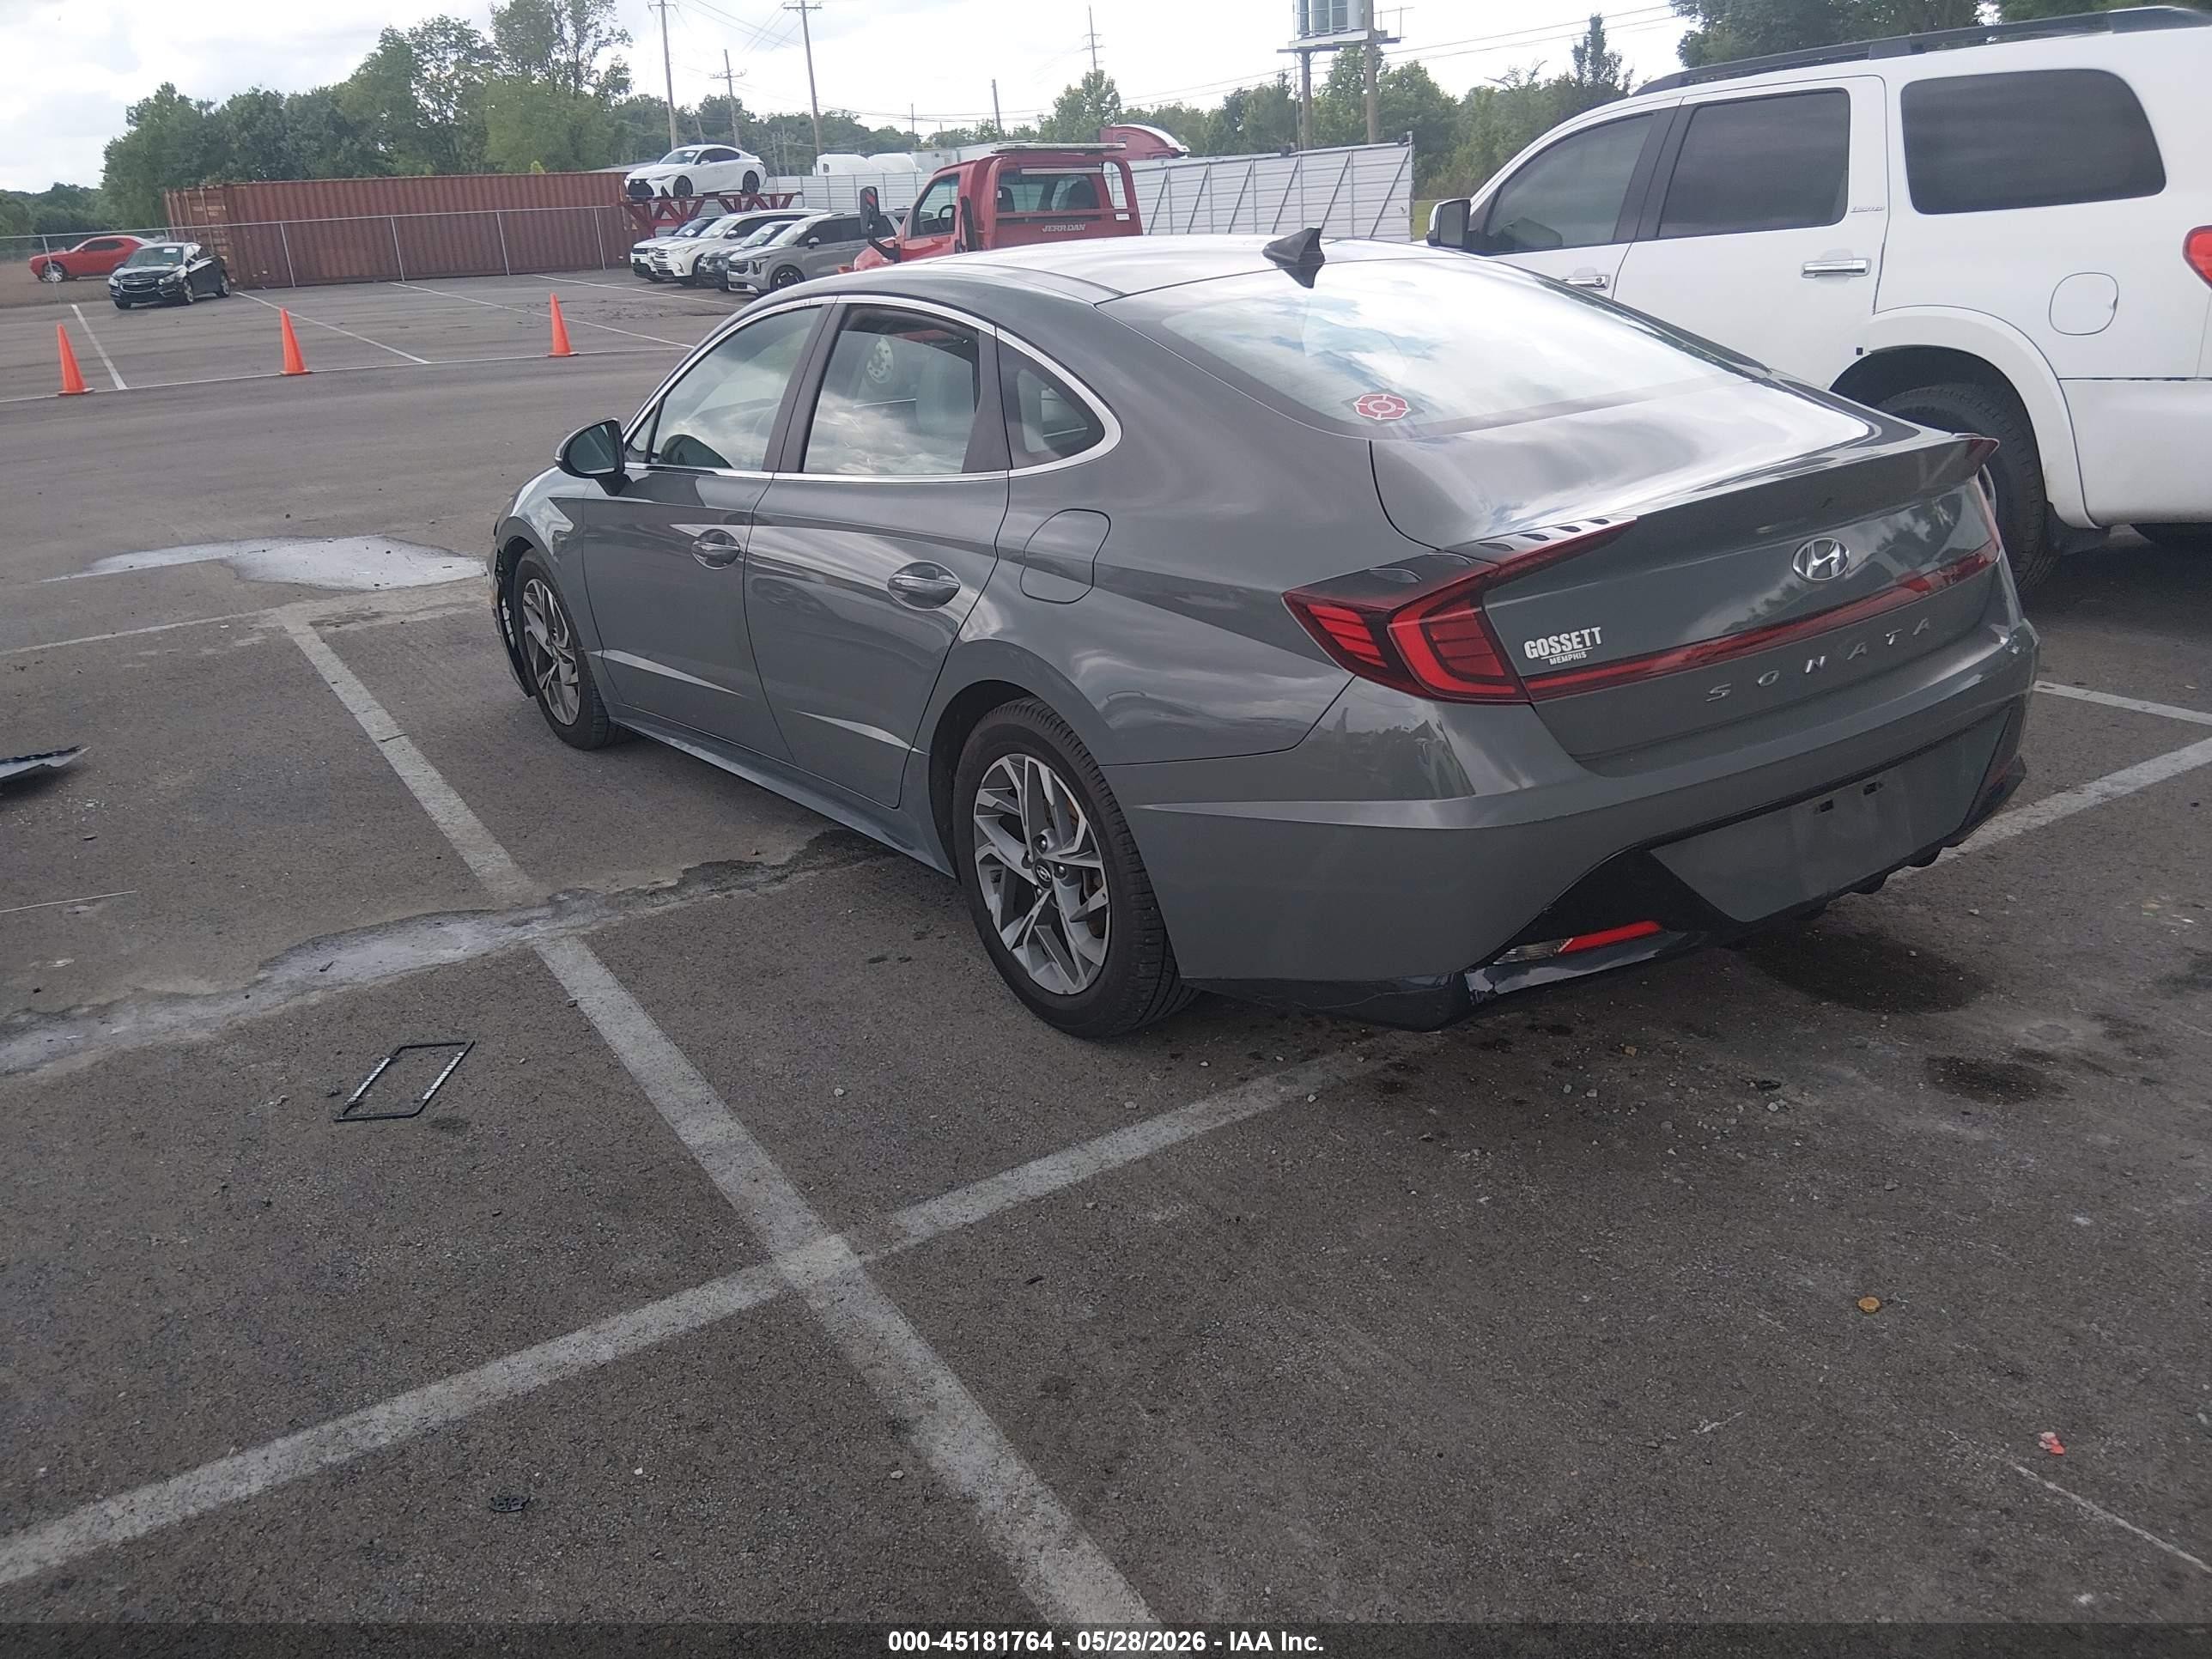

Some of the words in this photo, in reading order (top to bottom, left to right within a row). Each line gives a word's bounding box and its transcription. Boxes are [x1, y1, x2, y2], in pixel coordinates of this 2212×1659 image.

[1524, 627, 1601, 659] GOSSETT
[1549, 651, 1587, 665] MEMPHIS
[1705, 617, 1930, 702] SONATA
